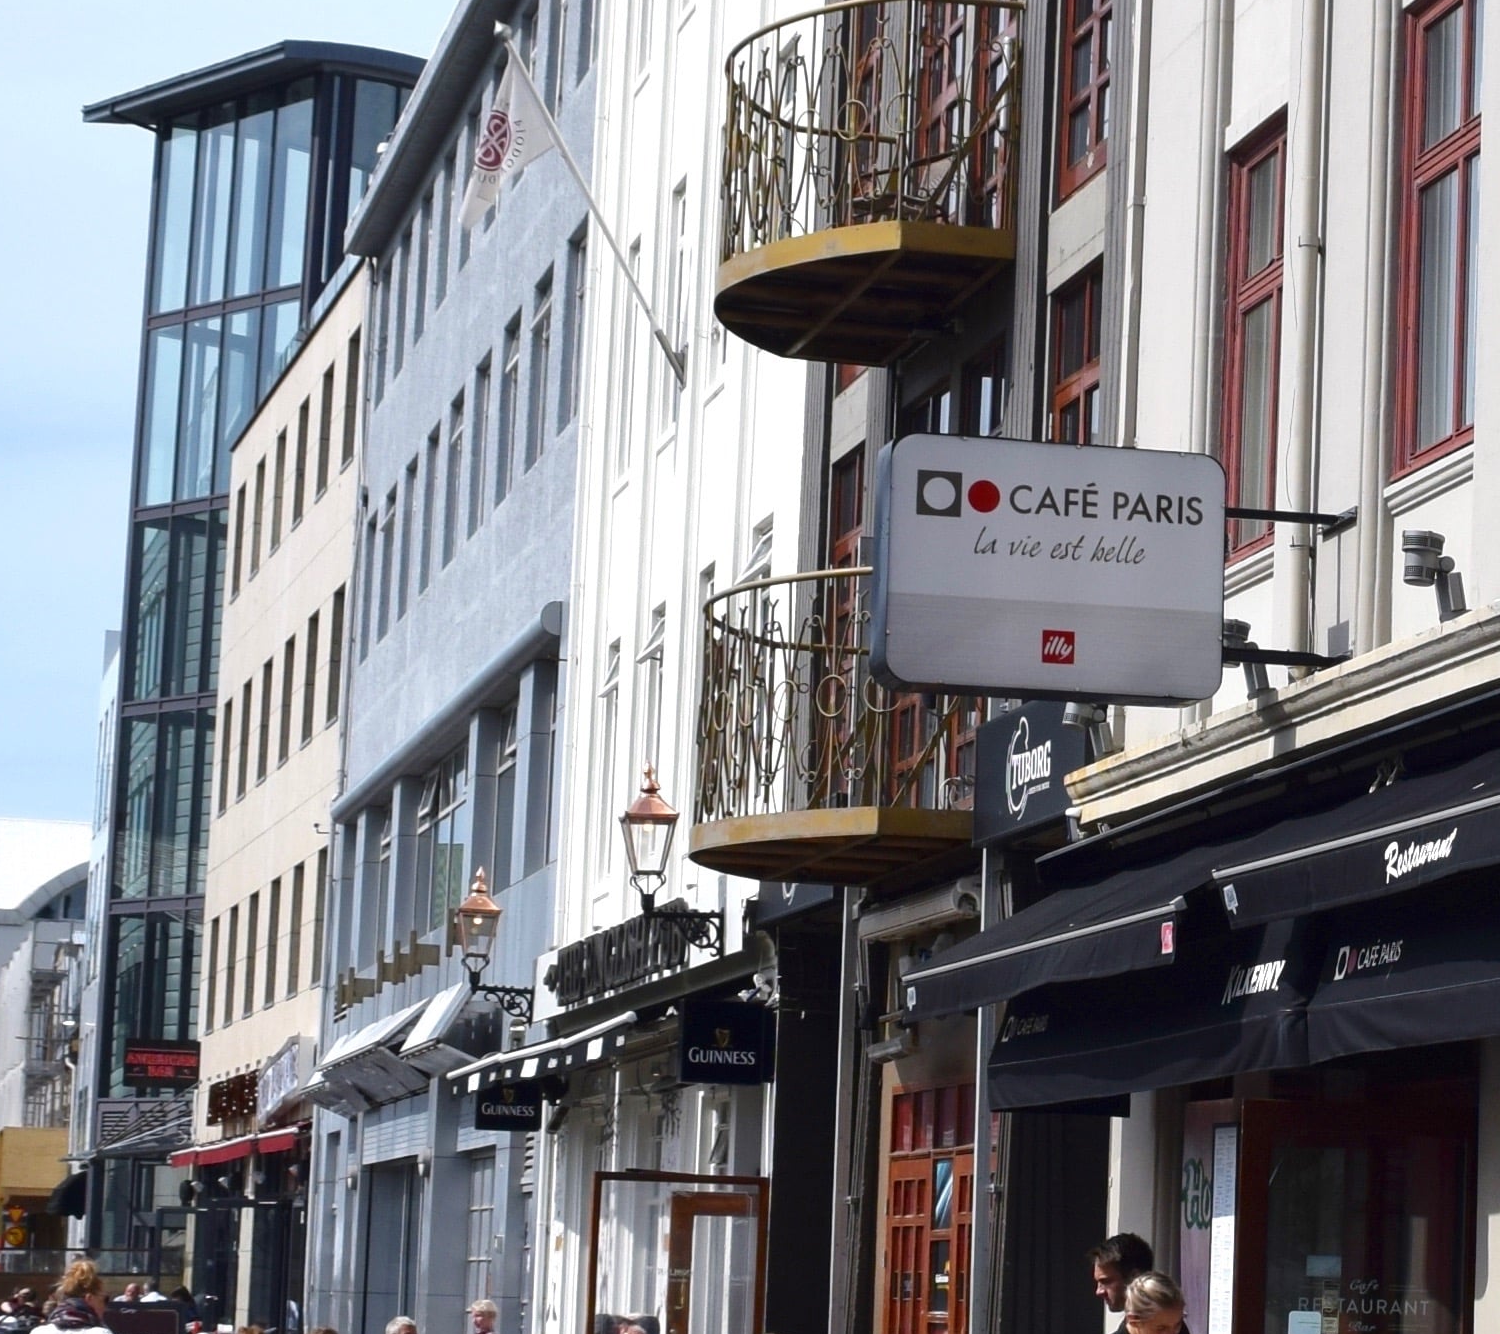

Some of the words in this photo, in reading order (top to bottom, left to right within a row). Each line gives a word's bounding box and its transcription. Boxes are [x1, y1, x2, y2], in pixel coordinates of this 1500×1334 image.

[1009, 482, 1099, 519] CAFÉ
[1113, 491, 1203, 526] PARIS
[974, 526, 997, 555] la
[1008, 536, 1042, 559] vie
[1051, 539, 1083, 562] est
[1090, 536, 1146, 565] belle
[1044, 635, 1073, 661] illy
[1011, 740, 1052, 790] TUBORG
[1384, 828, 1458, 884] Restaurant
[688, 1046, 756, 1066] GUINNESS
[481, 1103, 535, 1117] GUINNESS
[1349, 1278, 1380, 1295] Cafe
